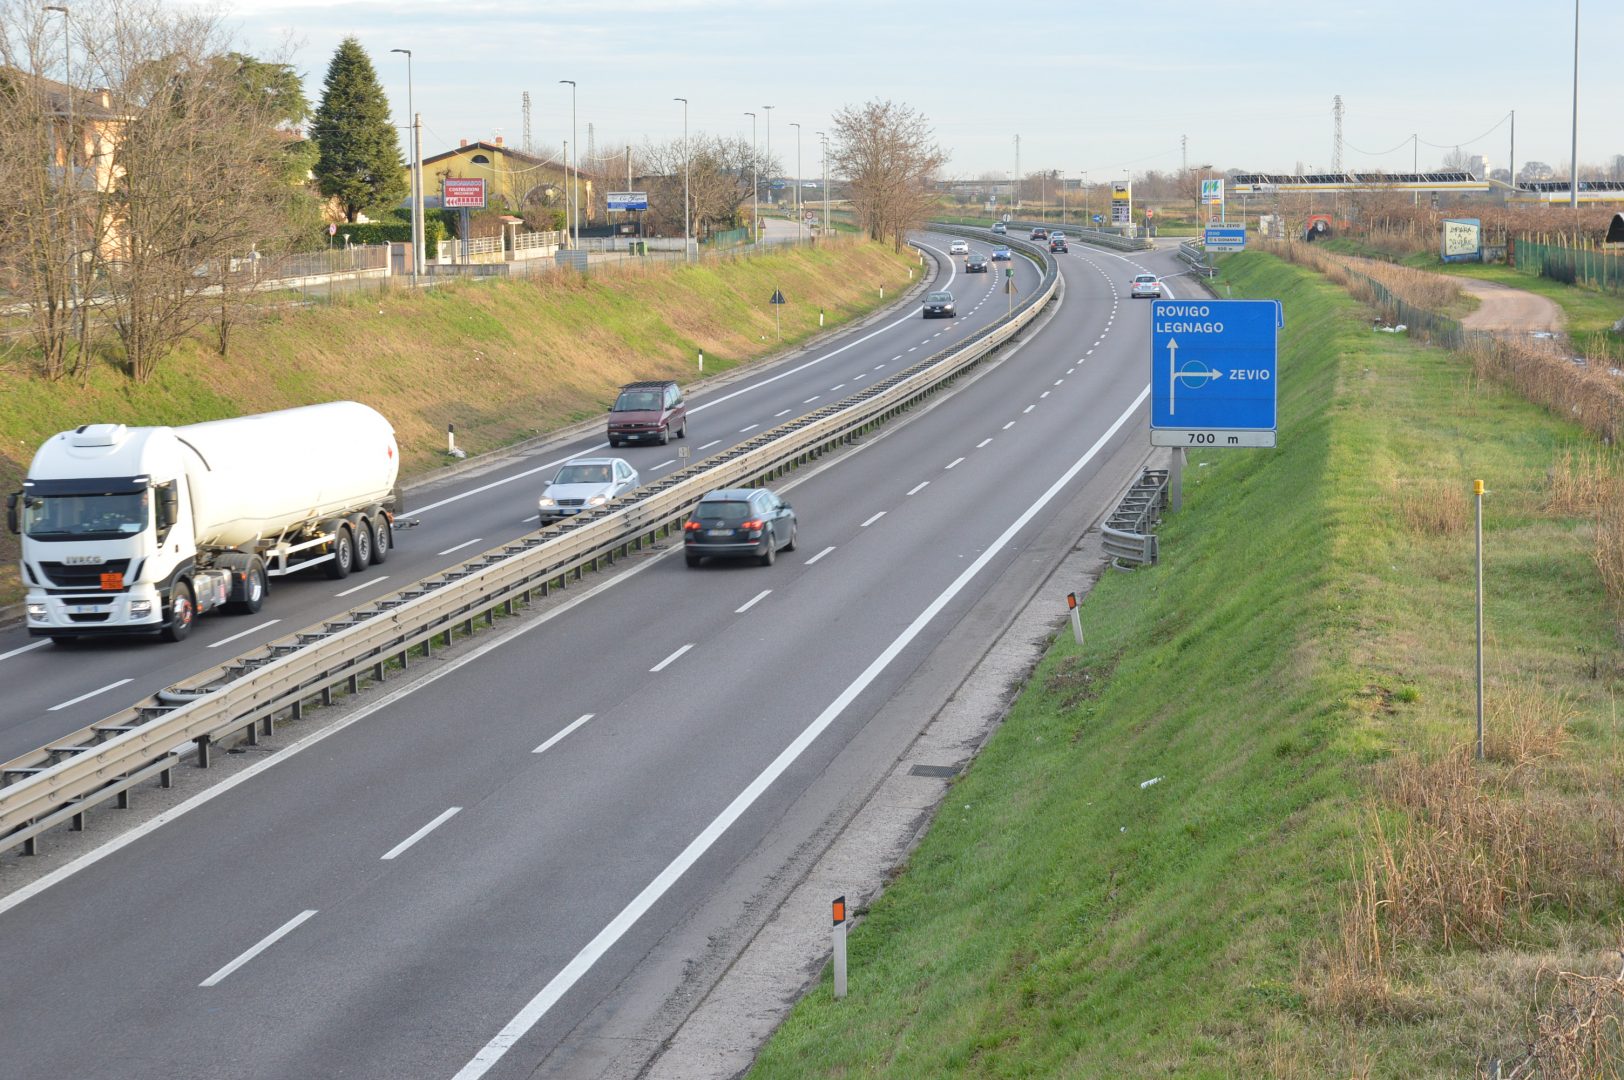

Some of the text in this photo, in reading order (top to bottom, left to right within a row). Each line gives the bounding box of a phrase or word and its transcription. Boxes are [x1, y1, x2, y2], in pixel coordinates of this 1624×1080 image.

[1156, 306, 1210, 317] ROVIGO
[1156, 322, 1224, 333] LEGNAGO
[1229, 369, 1270, 380] ZEVIO
[1188, 433, 1239, 444] 700 m
